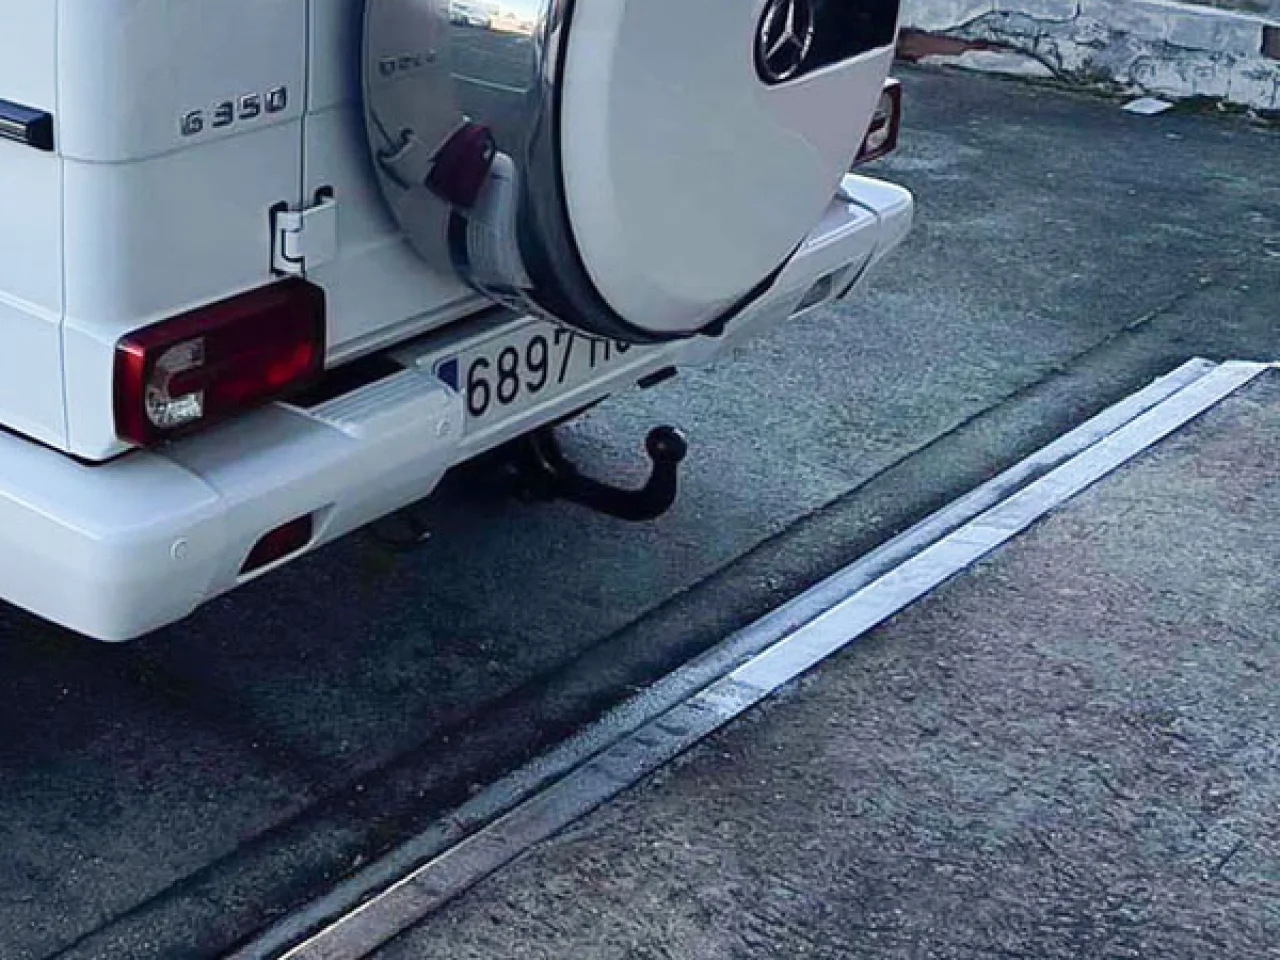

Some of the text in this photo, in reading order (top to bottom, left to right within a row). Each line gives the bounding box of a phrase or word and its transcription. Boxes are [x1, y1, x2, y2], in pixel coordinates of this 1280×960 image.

[179, 86, 287, 137] G 350
[466, 328, 574, 418] 6897
